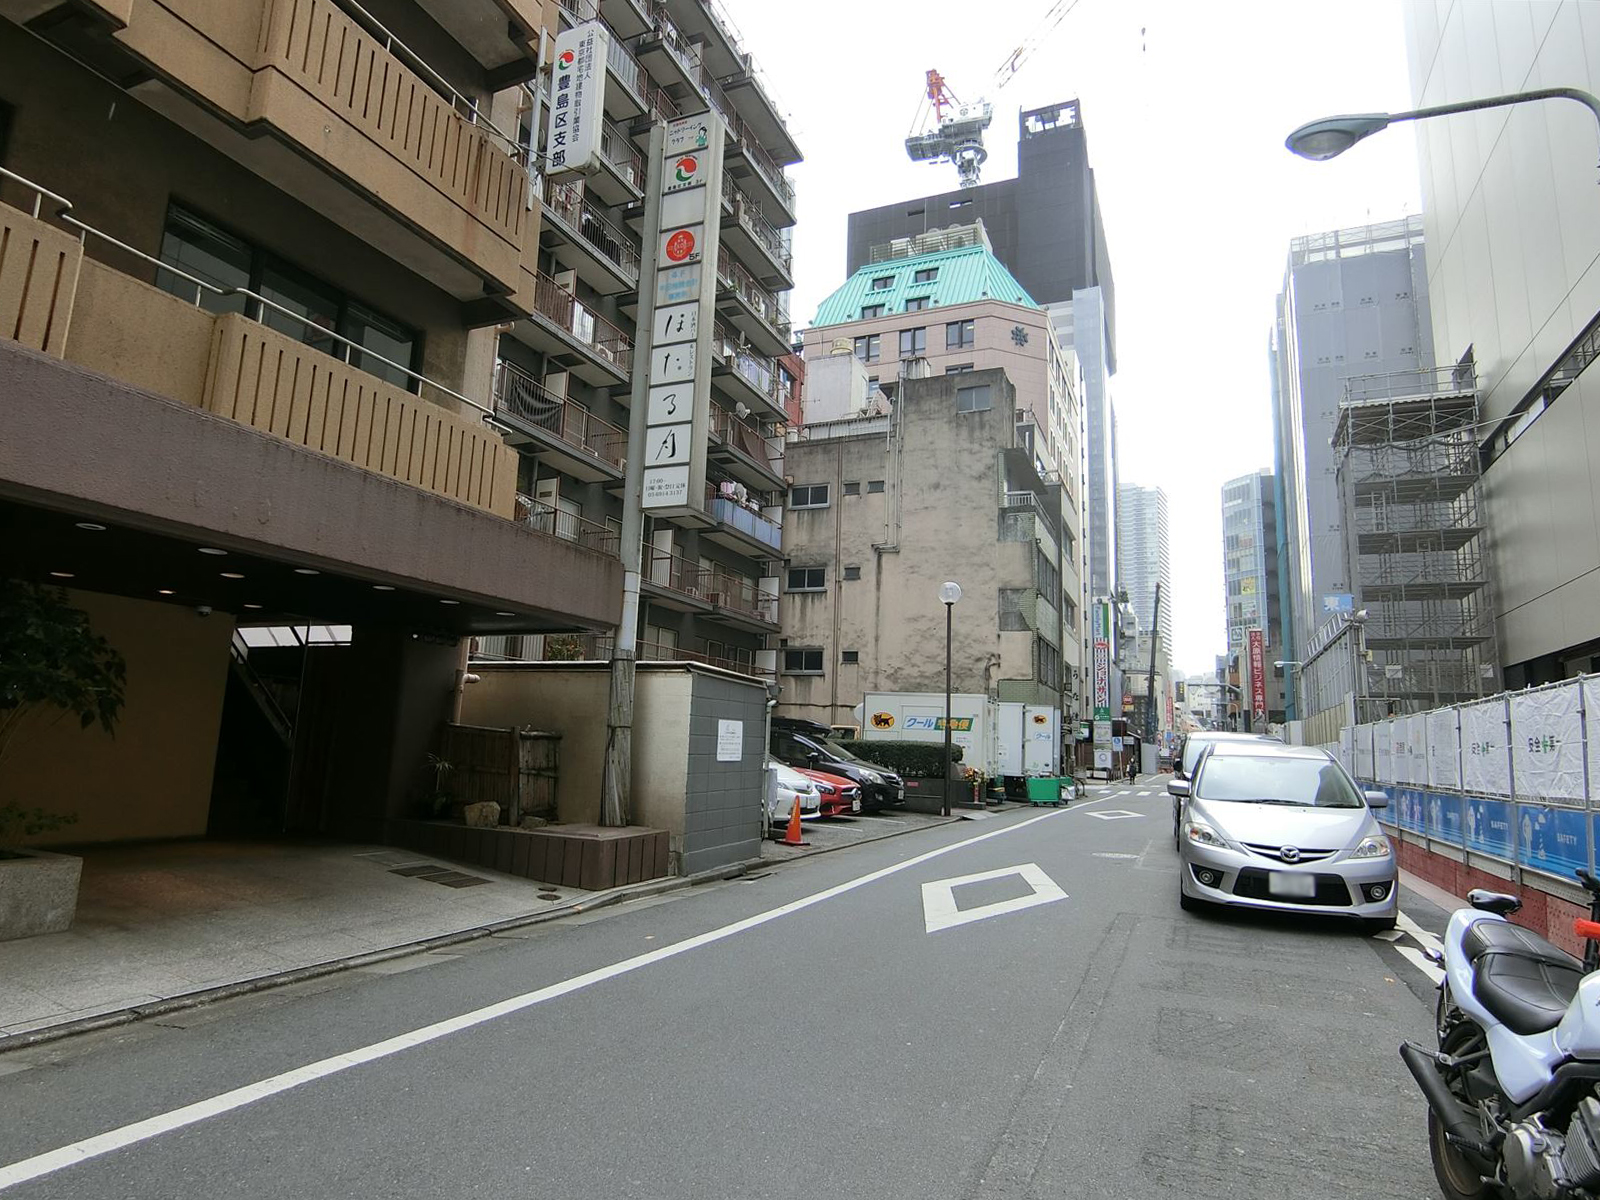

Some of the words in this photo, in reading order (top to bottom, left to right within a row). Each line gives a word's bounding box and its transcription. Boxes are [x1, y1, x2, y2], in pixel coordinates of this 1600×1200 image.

[689, 252, 700, 260] 5F
[1096, 662, 1107, 704] ジョナサン
[1490, 820, 1509, 831] SAFETY
[1556, 833, 1578, 845] SAFETY
